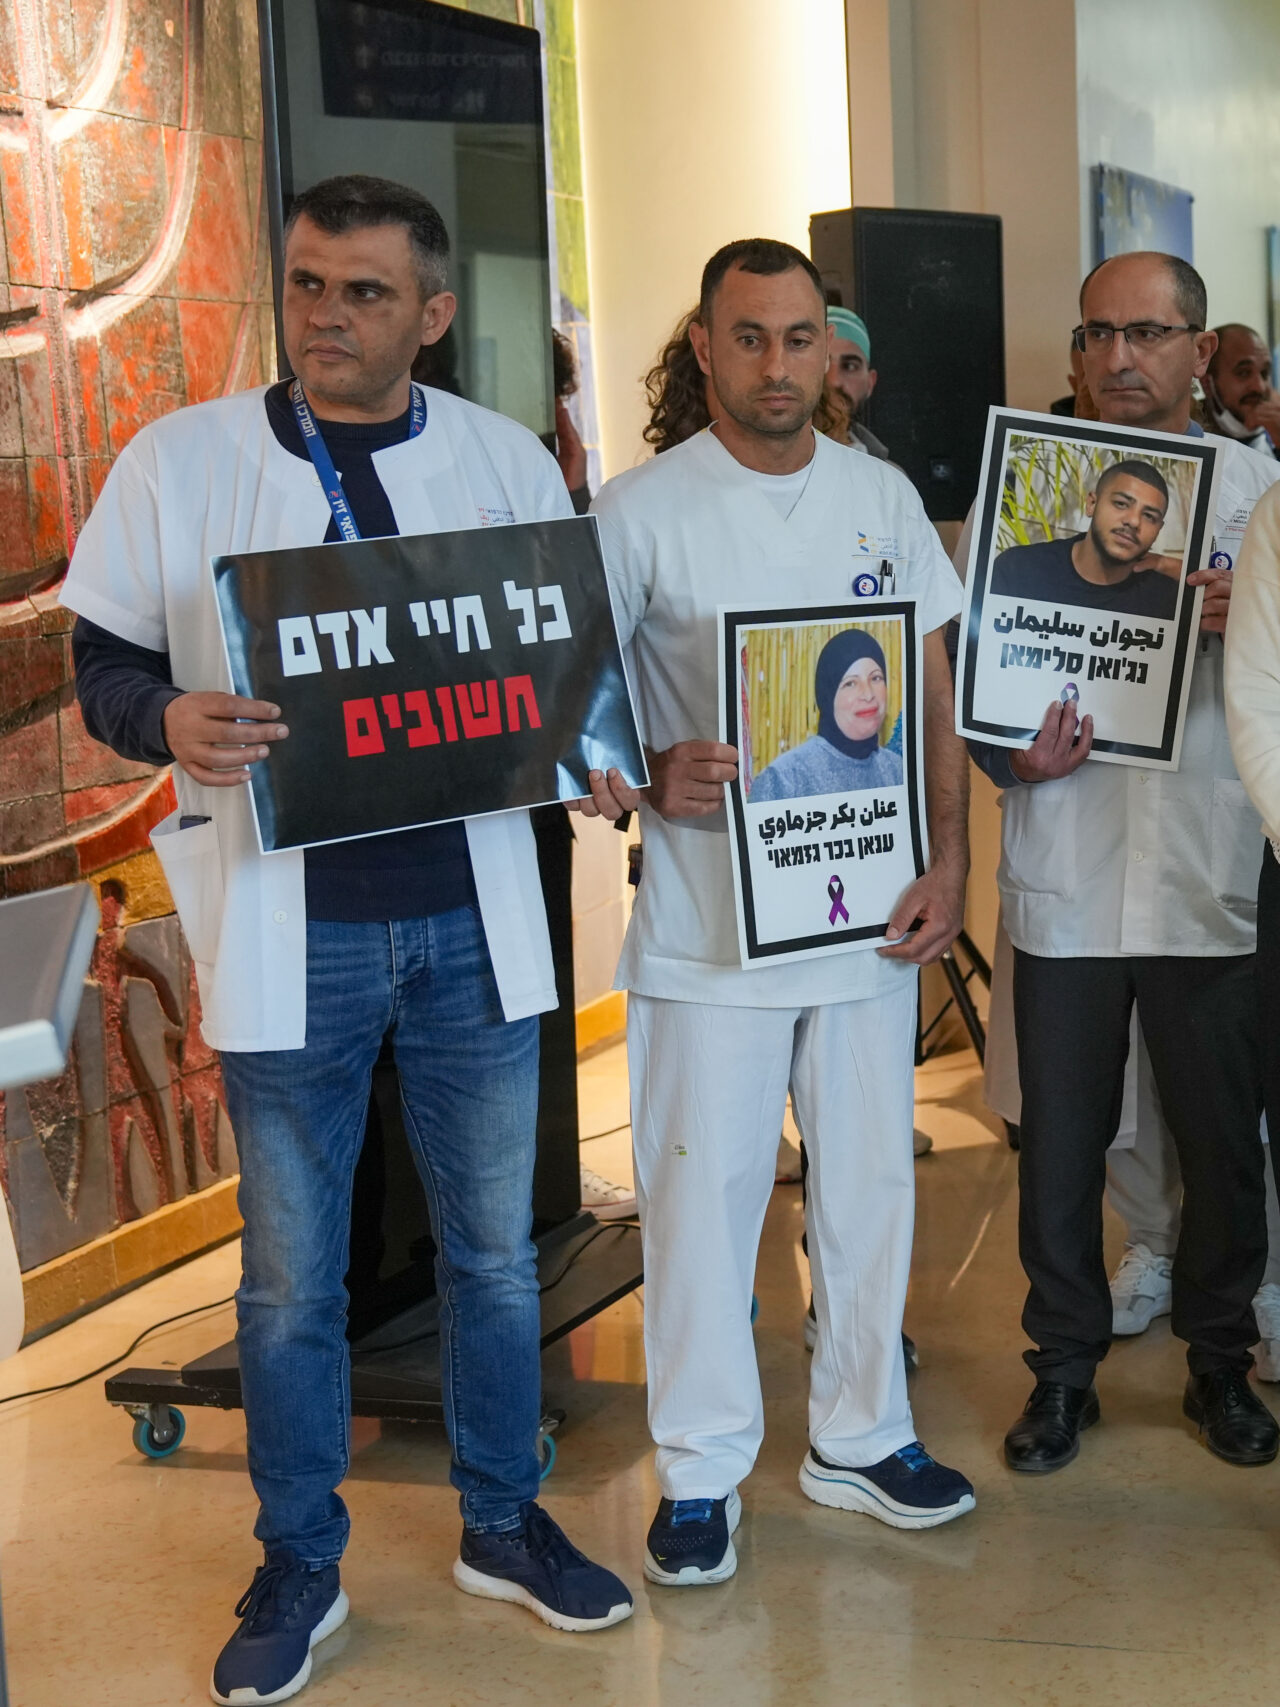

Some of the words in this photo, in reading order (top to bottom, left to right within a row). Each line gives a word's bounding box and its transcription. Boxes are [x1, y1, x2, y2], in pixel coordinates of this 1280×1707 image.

[297, 403, 317, 438] המרכז
[333, 498, 347, 514] זיו
[341, 515, 358, 541] פואי
[408, 594, 492, 653] חיי
[503, 580, 573, 645] כל
[993, 605, 1085, 640] سليمان
[277, 606, 395, 677] אדם
[1089, 619, 1165, 652] نجوان
[1000, 642, 1084, 674] סלימאן
[1087, 655, 1149, 685] נג'ואן
[342, 674, 542, 758] חשובים
[758, 809, 827, 845] جزماوي
[830, 802, 856, 830] بكر
[859, 799, 898, 827] عنان
[767, 843, 821, 869] גזמאוי
[823, 839, 855, 860] בכר
[857, 833, 895, 860] ענאן
